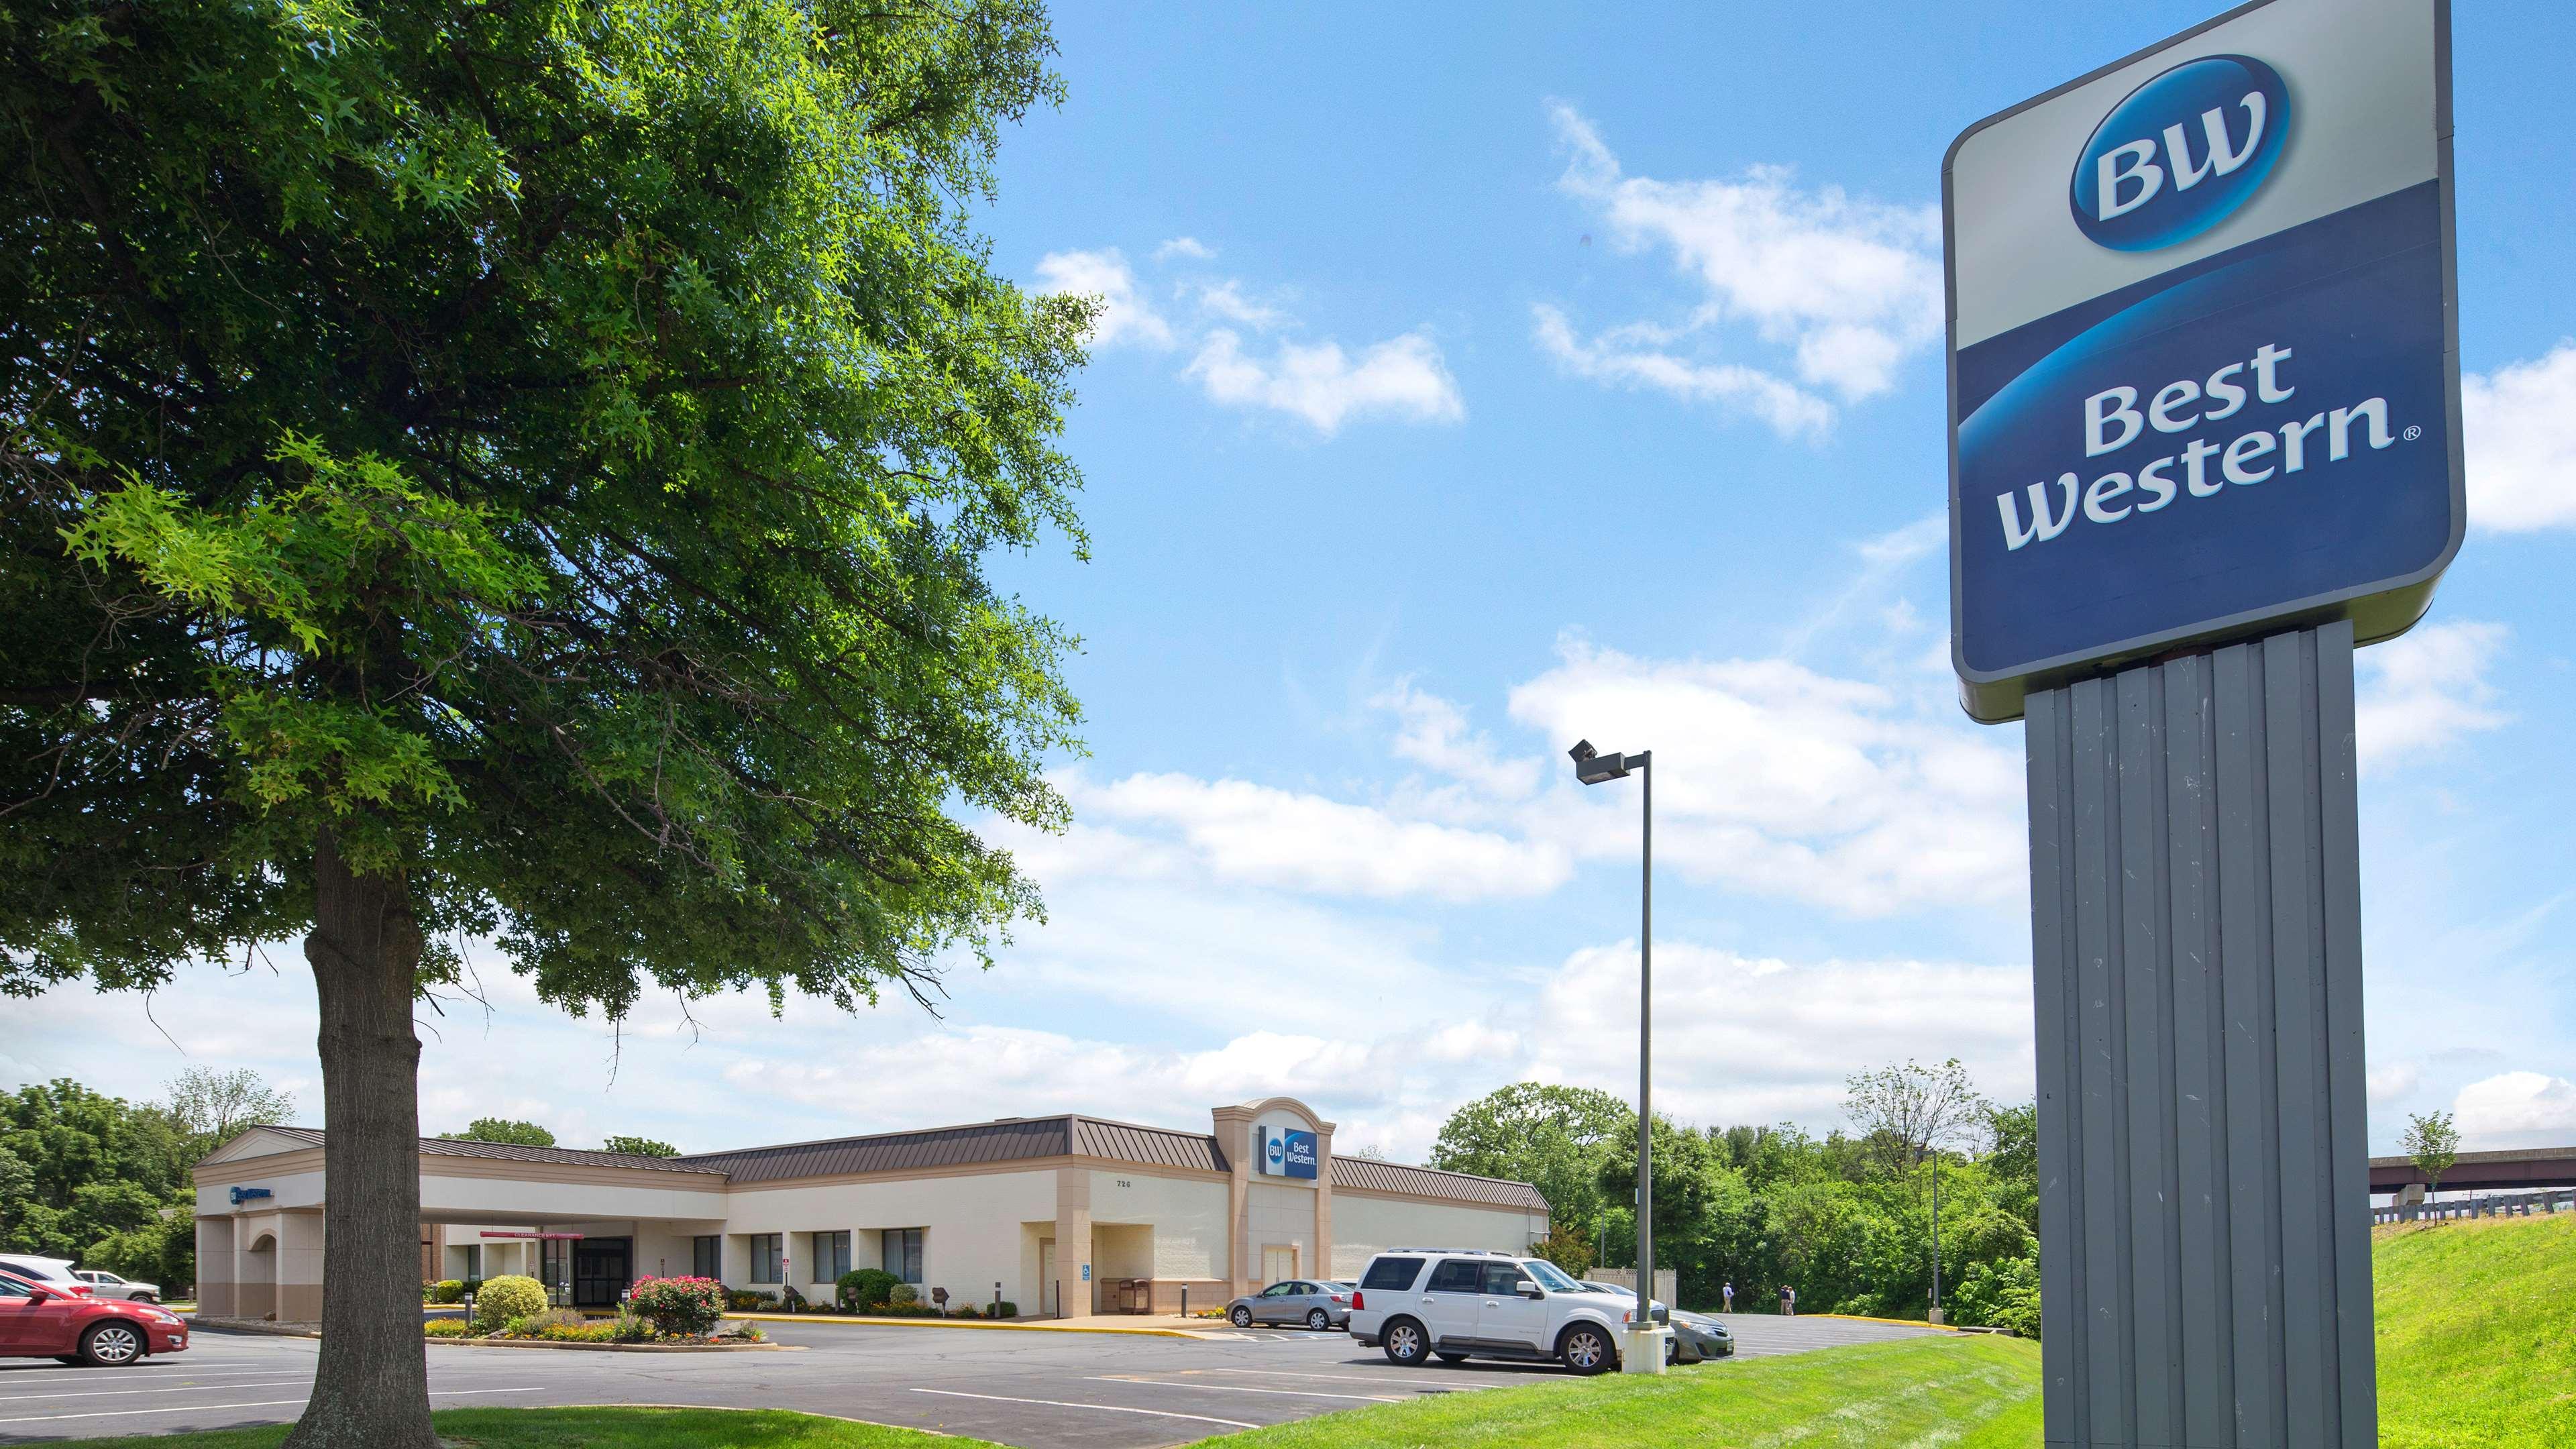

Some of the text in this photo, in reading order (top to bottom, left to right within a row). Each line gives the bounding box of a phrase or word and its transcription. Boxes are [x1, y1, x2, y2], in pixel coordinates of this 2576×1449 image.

[2098, 91, 2267, 222] BW
[2084, 343, 2295, 458] Best
[1269, 1145, 1282, 1157] BW
[1293, 1142, 1309, 1154] Best
[1287, 1152, 1315, 1165] Western
